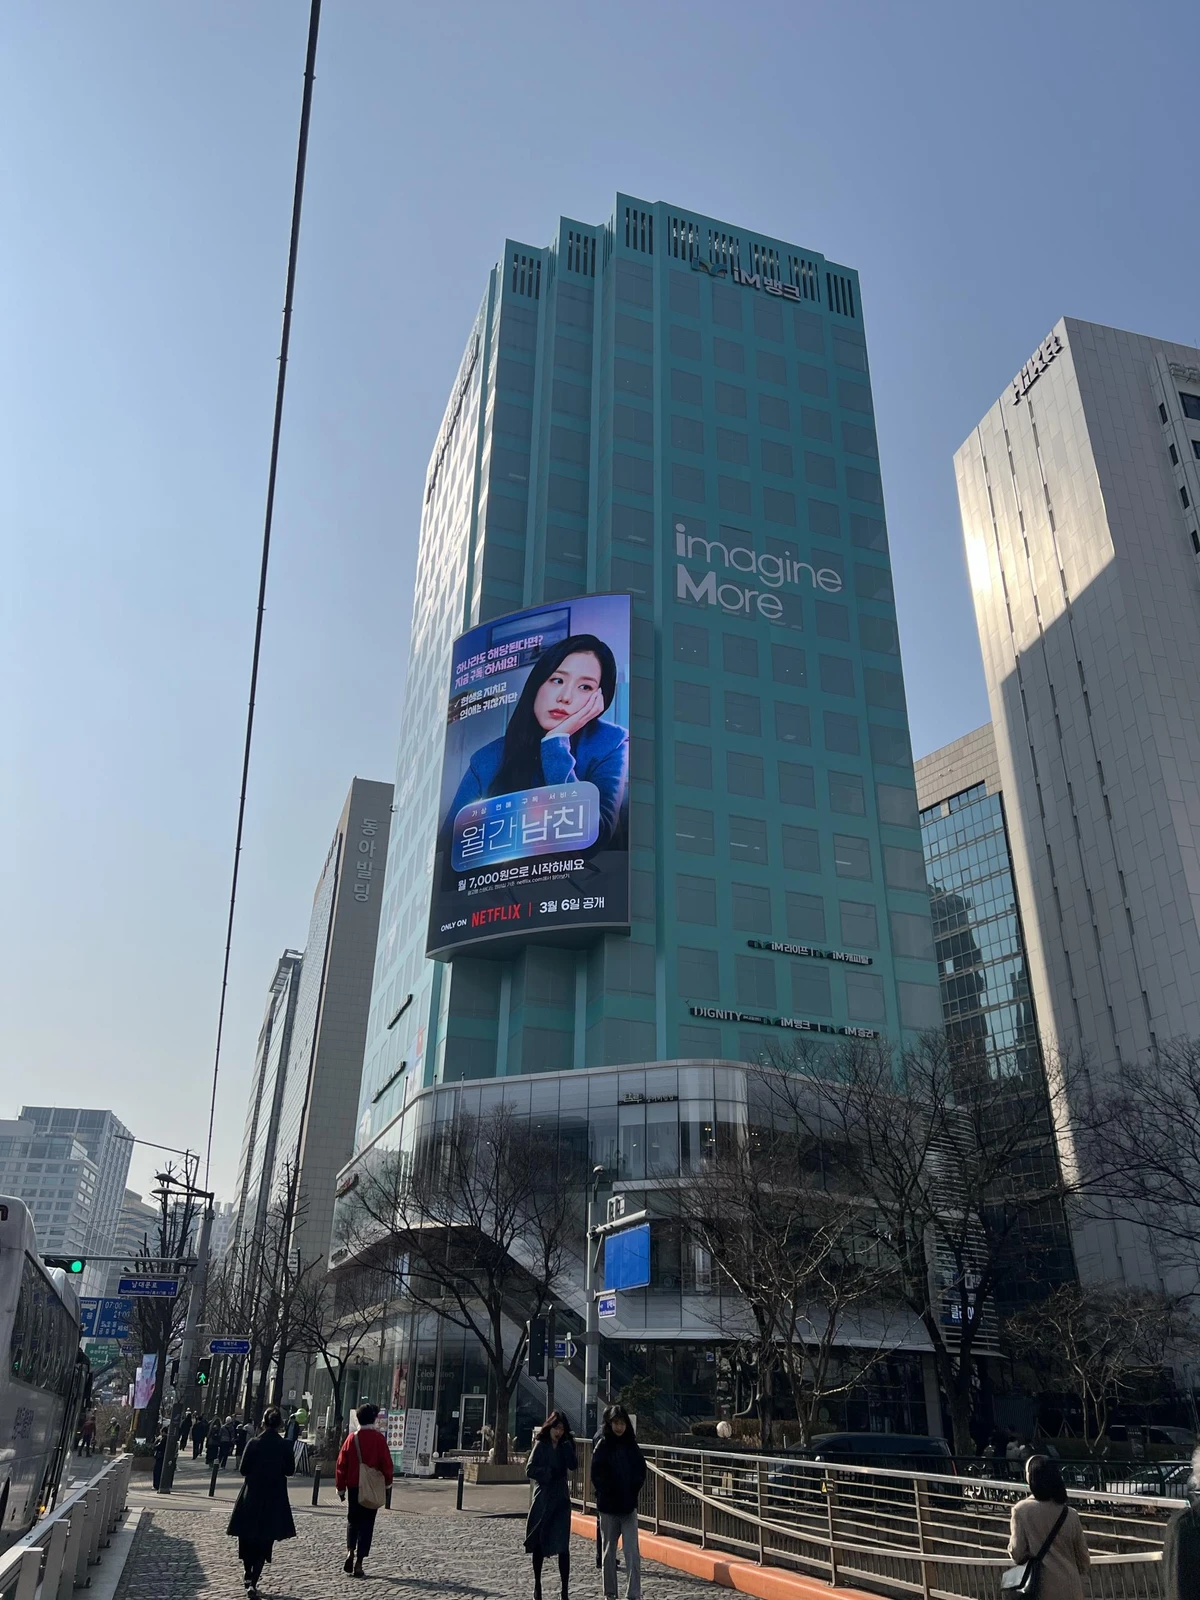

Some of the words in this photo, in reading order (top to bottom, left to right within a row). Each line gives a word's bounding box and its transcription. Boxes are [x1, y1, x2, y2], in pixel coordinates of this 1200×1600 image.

[675, 522, 843, 593] imagine
[676, 563, 784, 619] More
[457, 653, 486, 674] 하나라도
[488, 636, 543, 659] 해당된다면?
[454, 671, 469, 690] 지금
[460, 689, 483, 707] 현생은
[483, 681, 507, 696] 지치고
[459, 704, 482, 720] 연애는
[482, 692, 518, 711] 귀찮지만
[548, 789, 578, 801] 서비스
[353, 817, 379, 903] 동아빌딩
[457, 879, 467, 892] 월
[468, 865, 530, 889] 7,000원으로
[531, 858, 585, 877] 시작하세요
[440, 921, 456, 932] ONLY
[456, 918, 467, 928] ON
[471, 903, 521, 928] NETFLIX
[539, 900, 558, 914] 3월
[561, 898, 580, 911] 6일
[582, 896, 605, 910] 공개
[694, 1005, 743, 1021] DIGNITY
